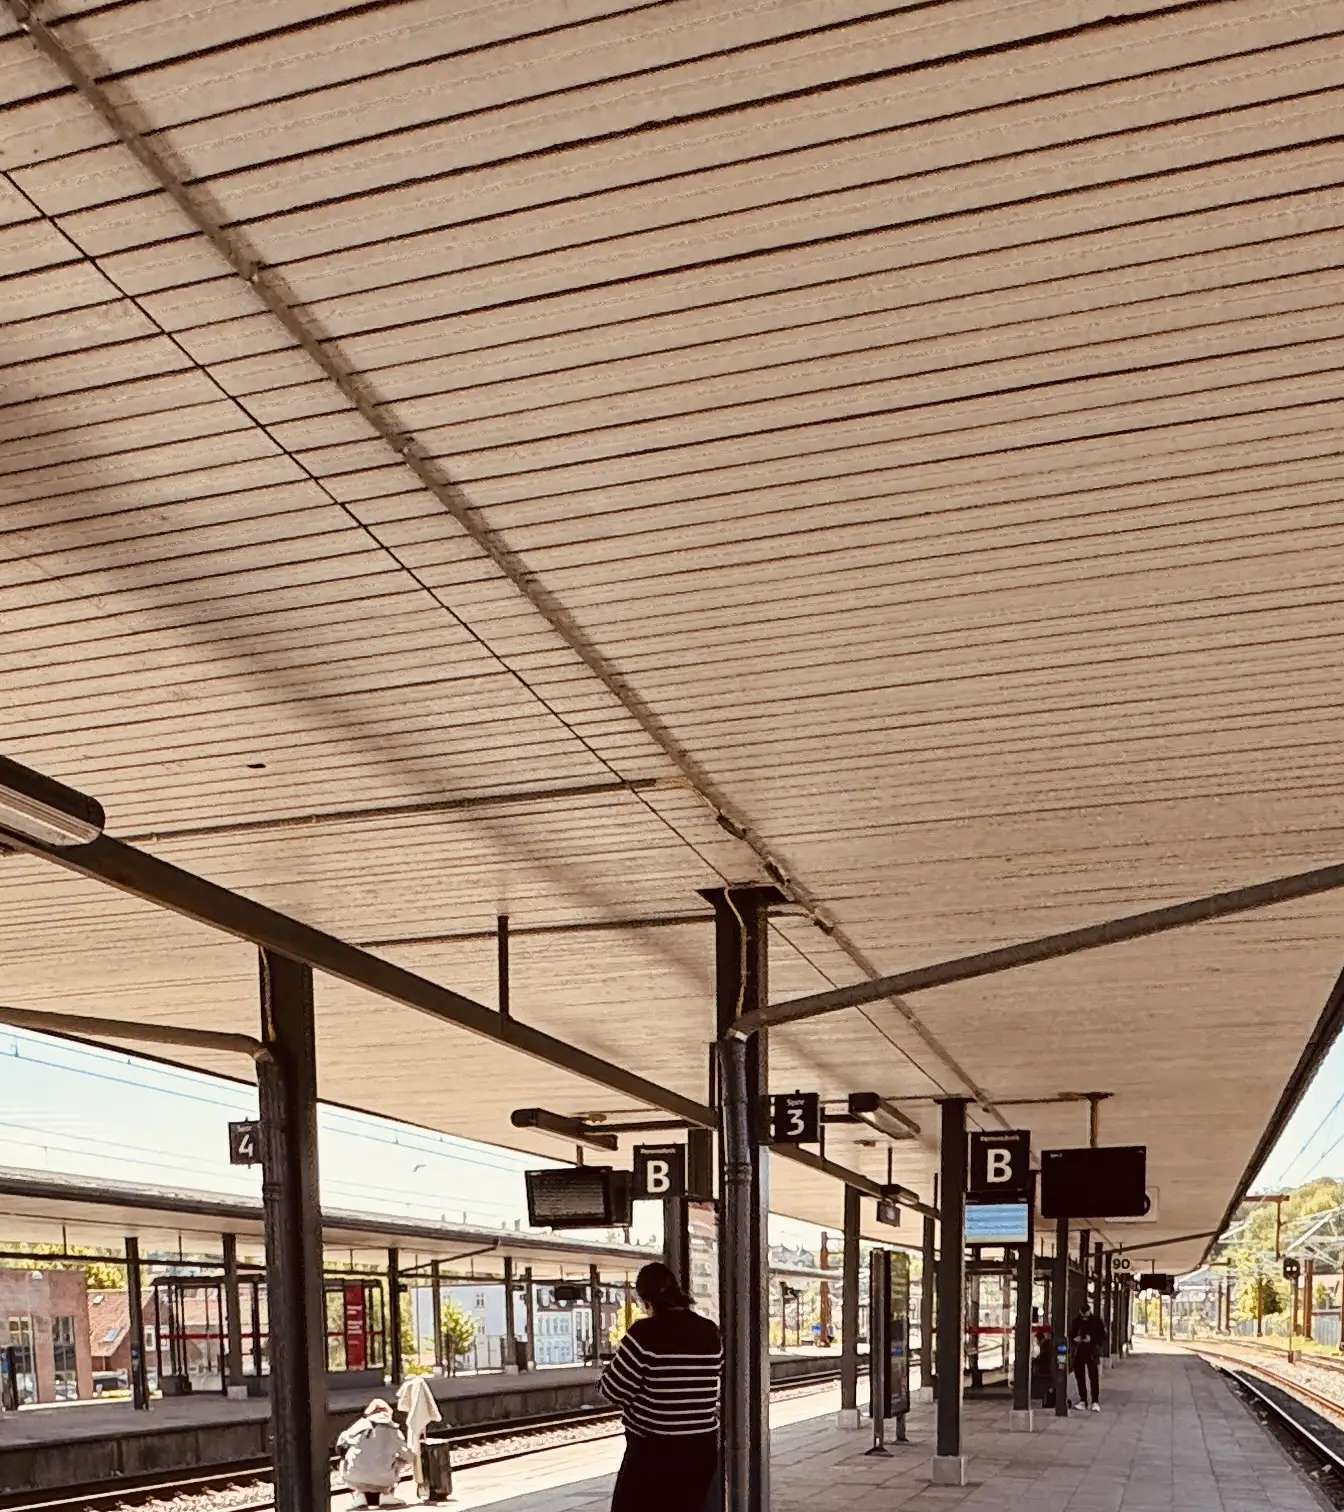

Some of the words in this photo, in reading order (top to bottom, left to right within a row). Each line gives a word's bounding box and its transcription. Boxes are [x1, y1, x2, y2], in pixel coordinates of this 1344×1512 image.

[786, 1108, 805, 1135] 3
[238, 1133, 254, 1158] 4
[646, 1160, 670, 1193] B
[987, 1148, 1013, 1183] B
[1112, 1258, 1131, 1269] 90
